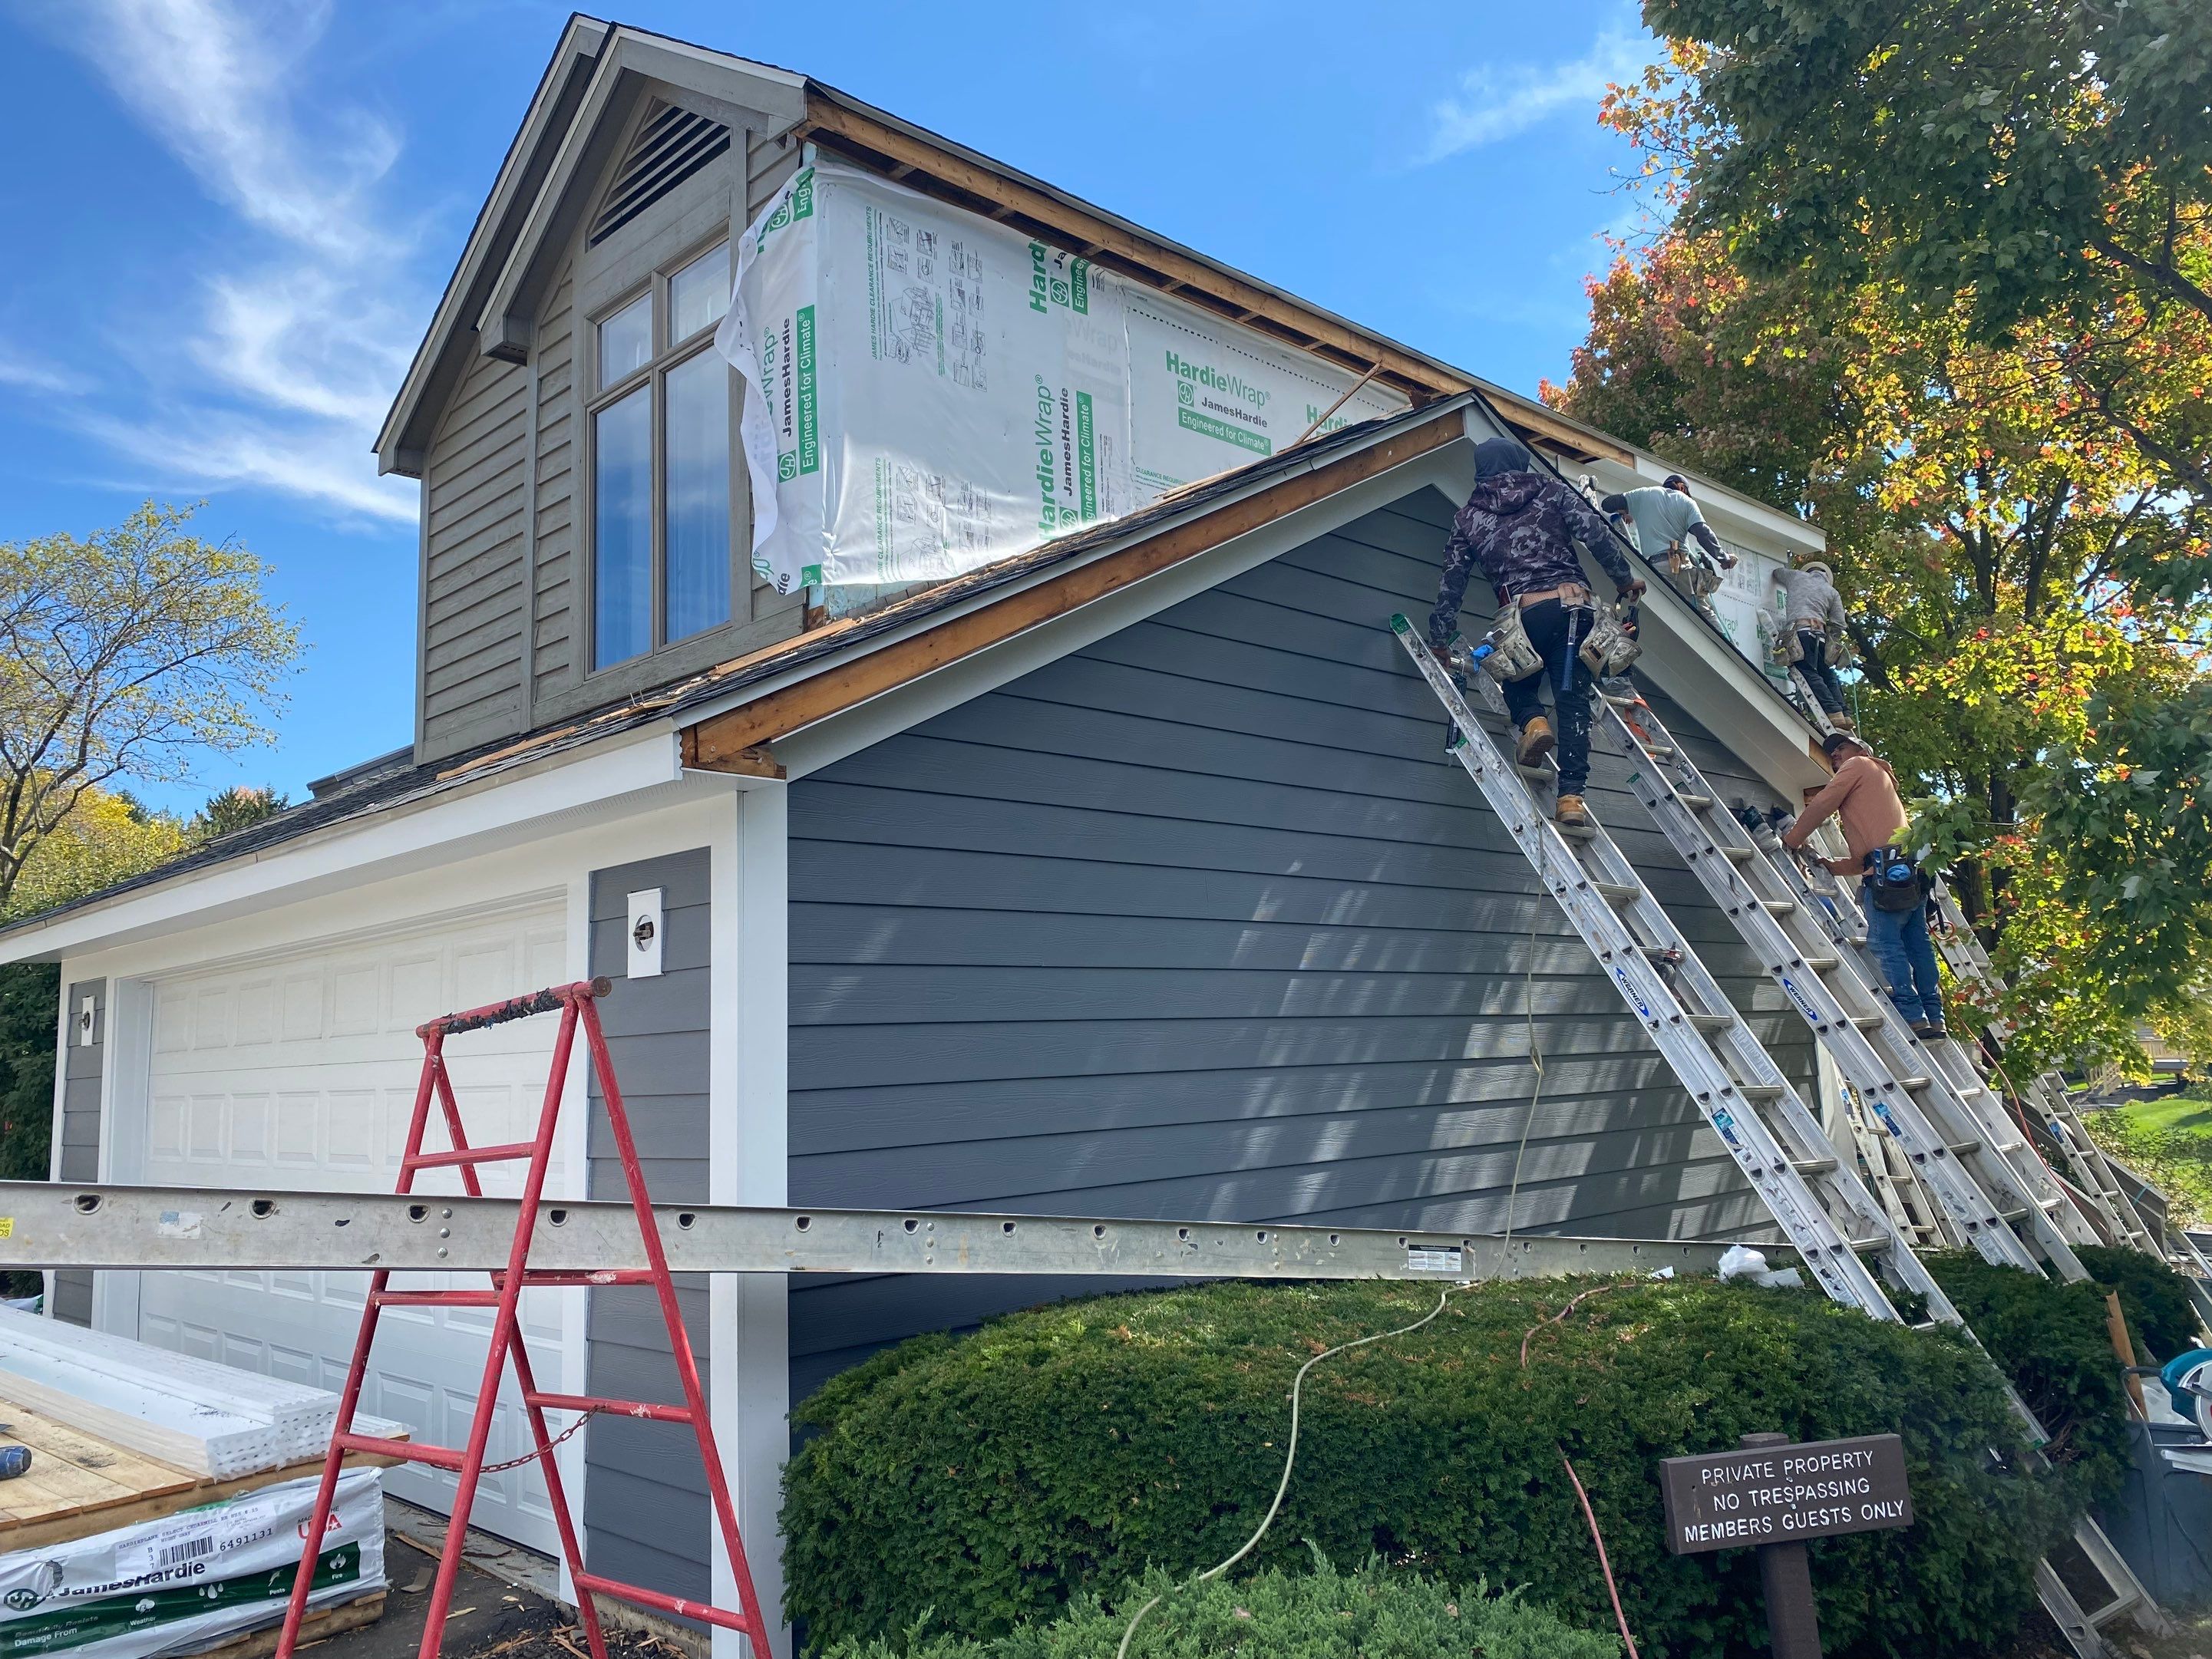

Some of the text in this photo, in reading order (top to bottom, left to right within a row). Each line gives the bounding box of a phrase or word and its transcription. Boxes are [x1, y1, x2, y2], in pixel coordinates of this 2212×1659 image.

[782, 318, 791, 437] JamesHardie
[802, 371, 812, 391] for
[1182, 411, 1224, 437] Engineered
[1226, 427, 1236, 440] for
[1202, 397, 1268, 428] JamesHardie
[1306, 404, 1348, 431] Hrd
[803, 392, 817, 468] Engineered
[1059, 388, 1073, 496] JamesHardie
[1082, 452, 1091, 467] for
[1082, 468, 1093, 528] ngineered
[1621, 977, 1643, 1008] WERNER
[1789, 987, 1813, 1012] WERNER
[1702, 1451, 1874, 1485] PRIVATE PROPERTY
[1714, 1477, 1870, 1512] NO TRESPASSING
[162, 1527, 183, 1536] SELECT
[298, 1515, 313, 1524] MAD
[298, 1514, 342, 1540] UA
[1685, 1499, 1904, 1543] MEMBERS GUESTS ONLY
[220, 1528, 272, 1552] 6491131
[58, 1562, 205, 1597] JamesHardie
[269, 1587, 286, 1596] Pests
[130, 1614, 157, 1627] Weather
[15, 1627, 78, 1648] Damage From
